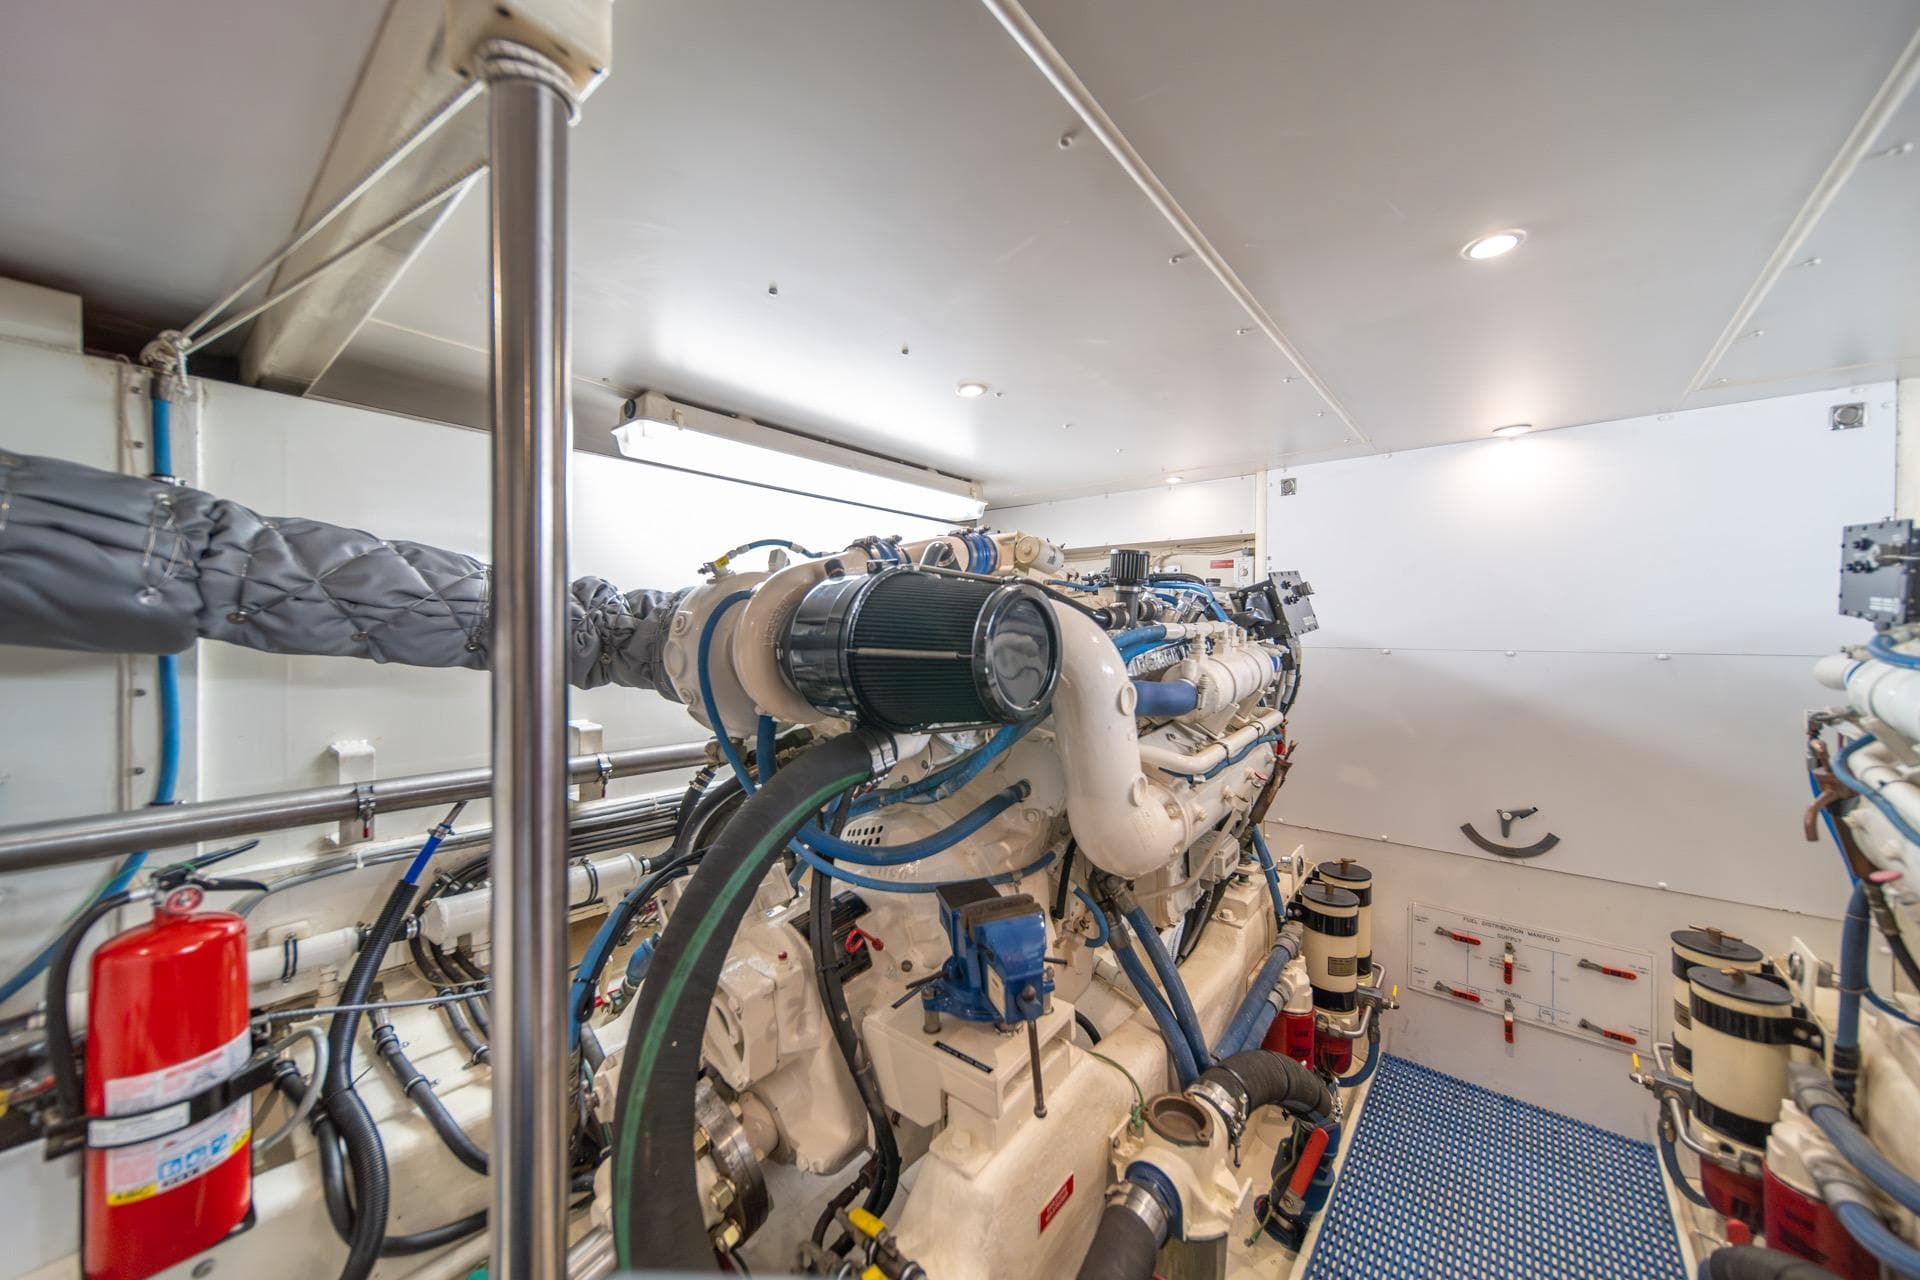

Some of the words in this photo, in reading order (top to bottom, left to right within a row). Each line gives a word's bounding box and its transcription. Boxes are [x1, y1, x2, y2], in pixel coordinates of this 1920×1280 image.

[1463, 917, 1478, 925] FUEL
[1481, 921, 1524, 934] DISTRIBUTION
[1527, 931, 1560, 943] MANIFOLD
[1497, 933, 1522, 943] SUPPLY
[1496, 988, 1522, 999] RETURN
